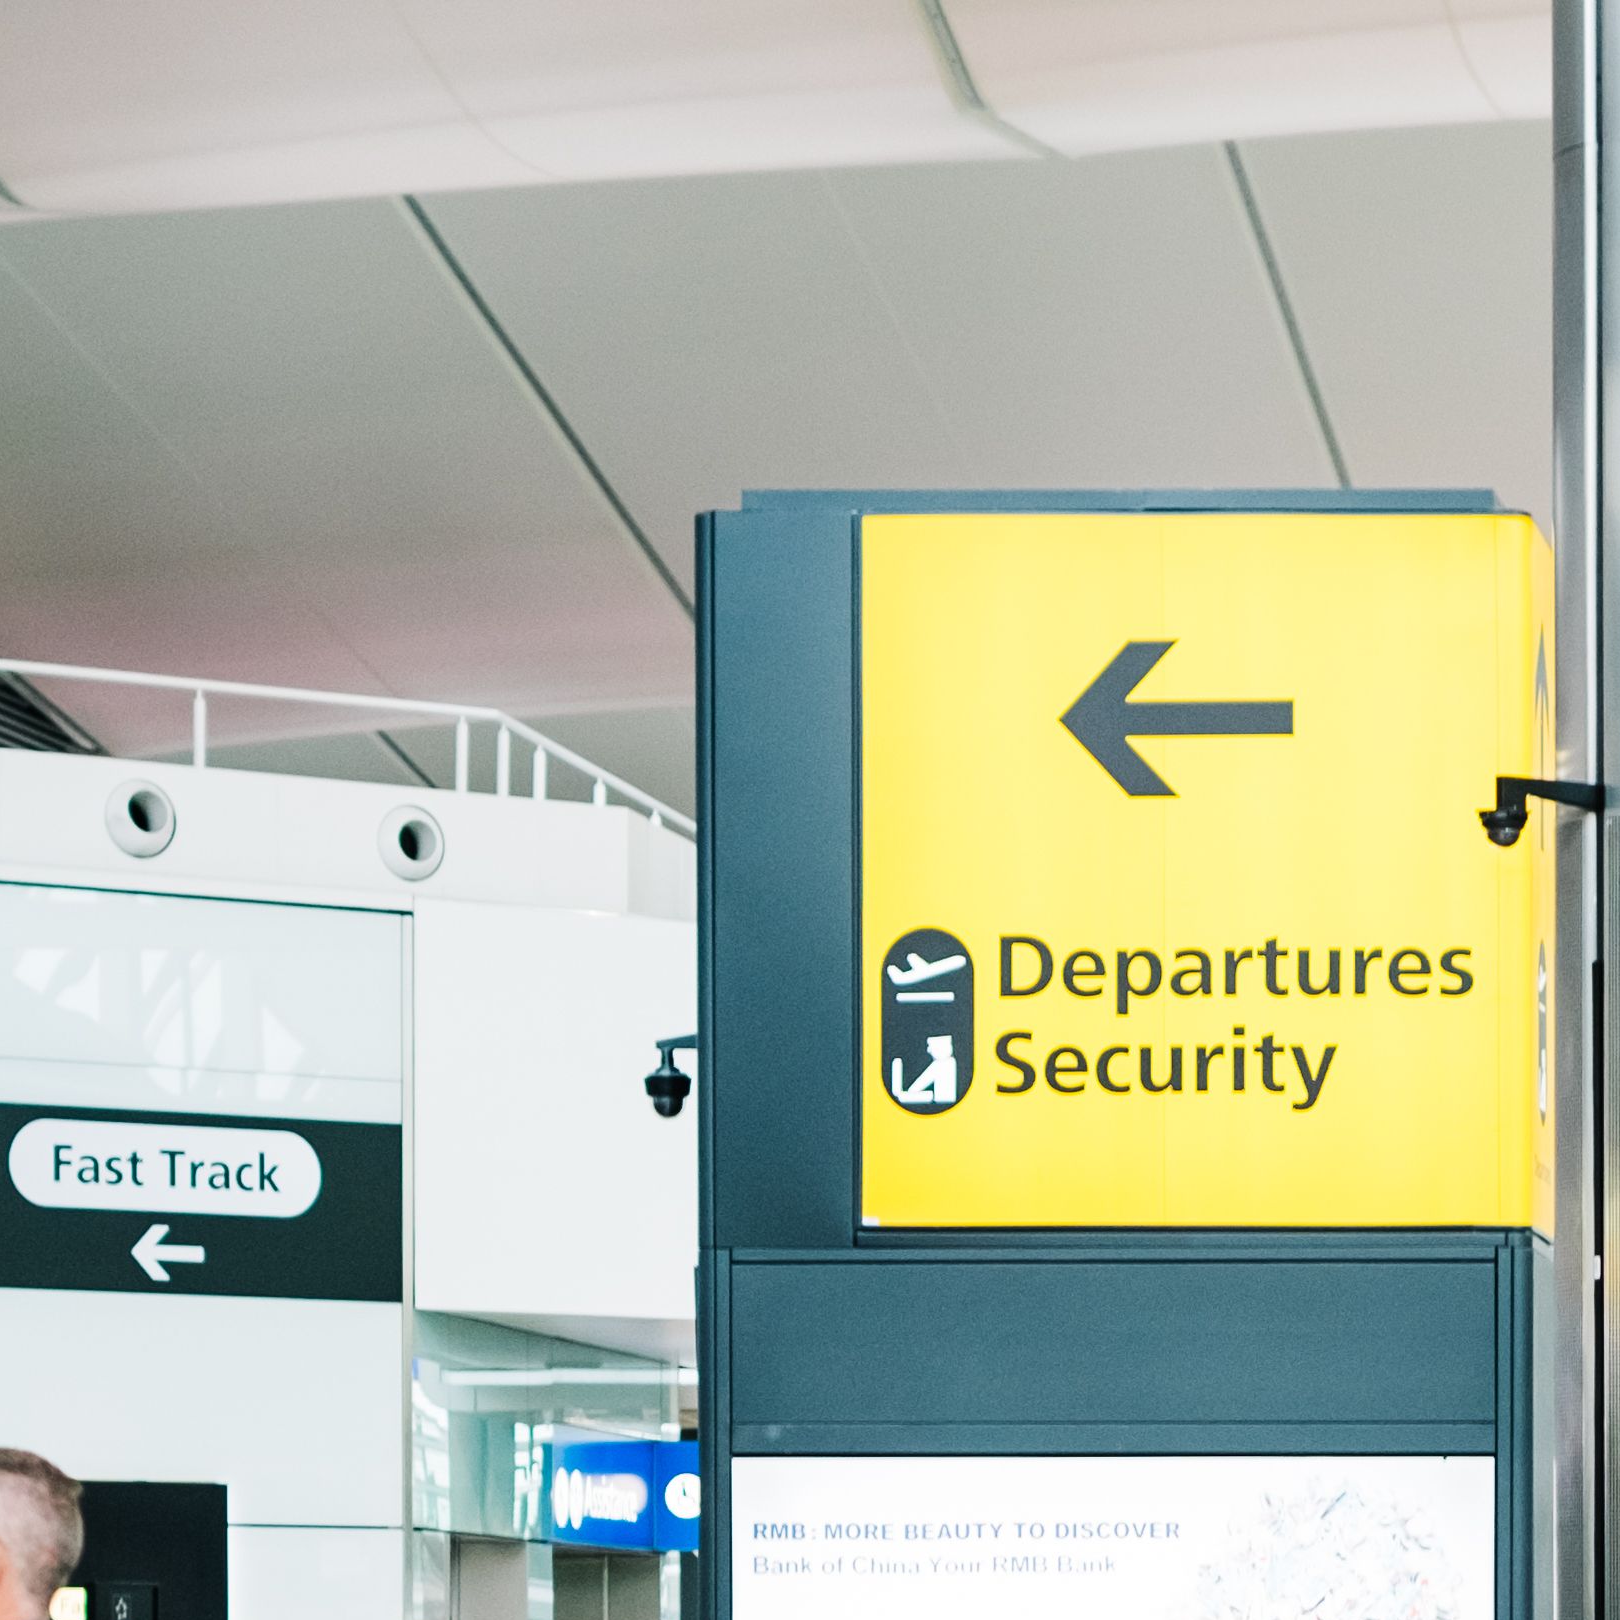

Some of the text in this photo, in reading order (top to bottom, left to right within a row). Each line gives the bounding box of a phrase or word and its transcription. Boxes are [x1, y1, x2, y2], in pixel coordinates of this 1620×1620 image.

[997, 935, 1474, 1014] Departures
[994, 1027, 1337, 1111] Security
[52, 1144, 280, 1193] Fast Track
[824, 1523, 894, 1541] MORE
[904, 1523, 1003, 1541] BEAUTY
[1013, 1523, 1045, 1540] TO
[1055, 1522, 1179, 1540] DISCOVER
[753, 1555, 1116, 1575] Bank of China Your RMB Bank
